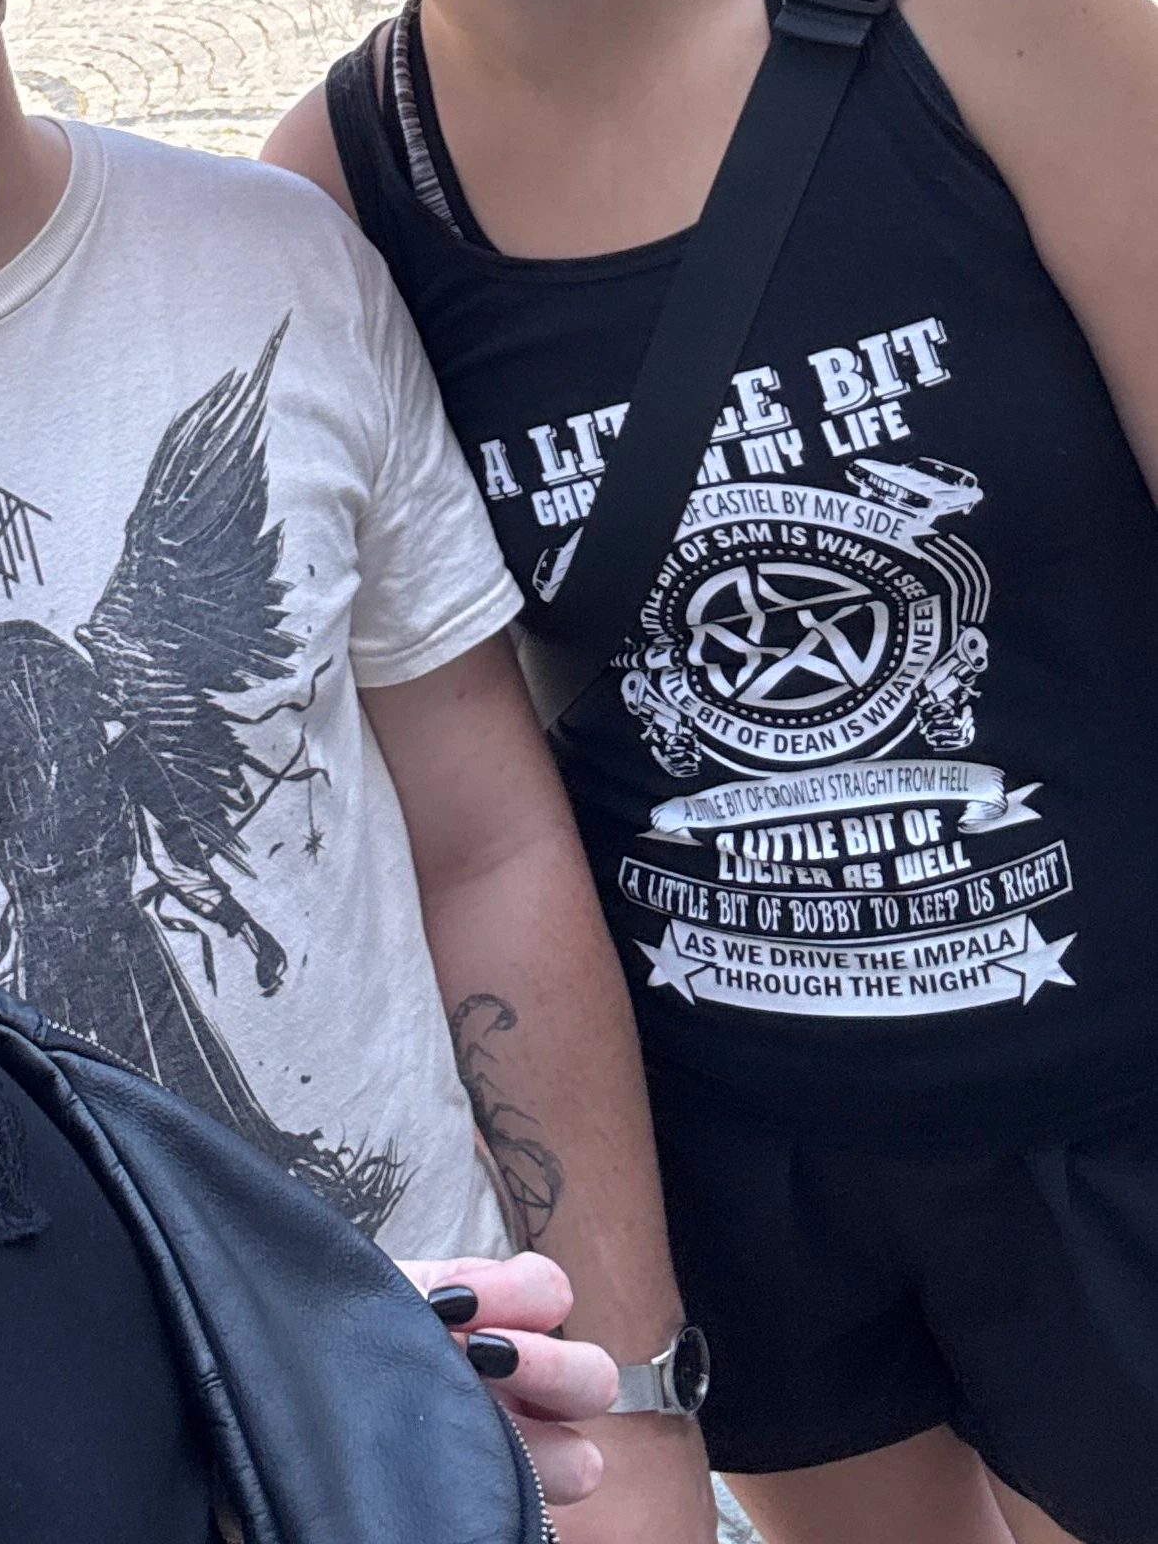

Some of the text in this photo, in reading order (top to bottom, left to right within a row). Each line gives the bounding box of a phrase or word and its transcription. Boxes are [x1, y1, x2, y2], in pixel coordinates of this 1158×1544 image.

[480, 439, 523, 501] A
[807, 317, 951, 416] BIT
[741, 428, 805, 476] MY
[820, 400, 912, 458] LIFE
[682, 488, 907, 542] OF CASTIEL BY MY SIDE
[657, 552, 684, 588] BIT
[679, 534, 710, 564] OF
[713, 522, 774, 549] SAM
[780, 523, 808, 546] IS
[816, 530, 893, 572] WHAT
[883, 565, 903, 579] I
[893, 573, 929, 600] SEE
[696, 707, 735, 737] BIT
[737, 727, 768, 751] OF
[774, 727, 840, 754] DEAN
[839, 718, 865, 743] IS
[861, 668, 918, 727] WHAT
[907, 660, 925, 668] I
[683, 799, 694, 822] A
[724, 788, 747, 817] BIT
[745, 786, 764, 812] OF
[764, 776, 828, 809] CROWLEY
[828, 768, 894, 802] STRAIGHT
[897, 766, 937, 793] FROM
[941, 765, 970, 793] HELL
[742, 820, 840, 862] LITTLE
[841, 812, 897, 856] BIT
[902, 808, 943, 847] OF
[626, 851, 1060, 934] A LITTLE BIT OF BOBBY TO KEEP US RIGHT
[718, 840, 972, 889] LUCIFER AS WELL
[684, 927, 1016, 970] AS WE DRIVE THE IMPALA
[711, 963, 993, 997] THROUGH THE NIGHT
